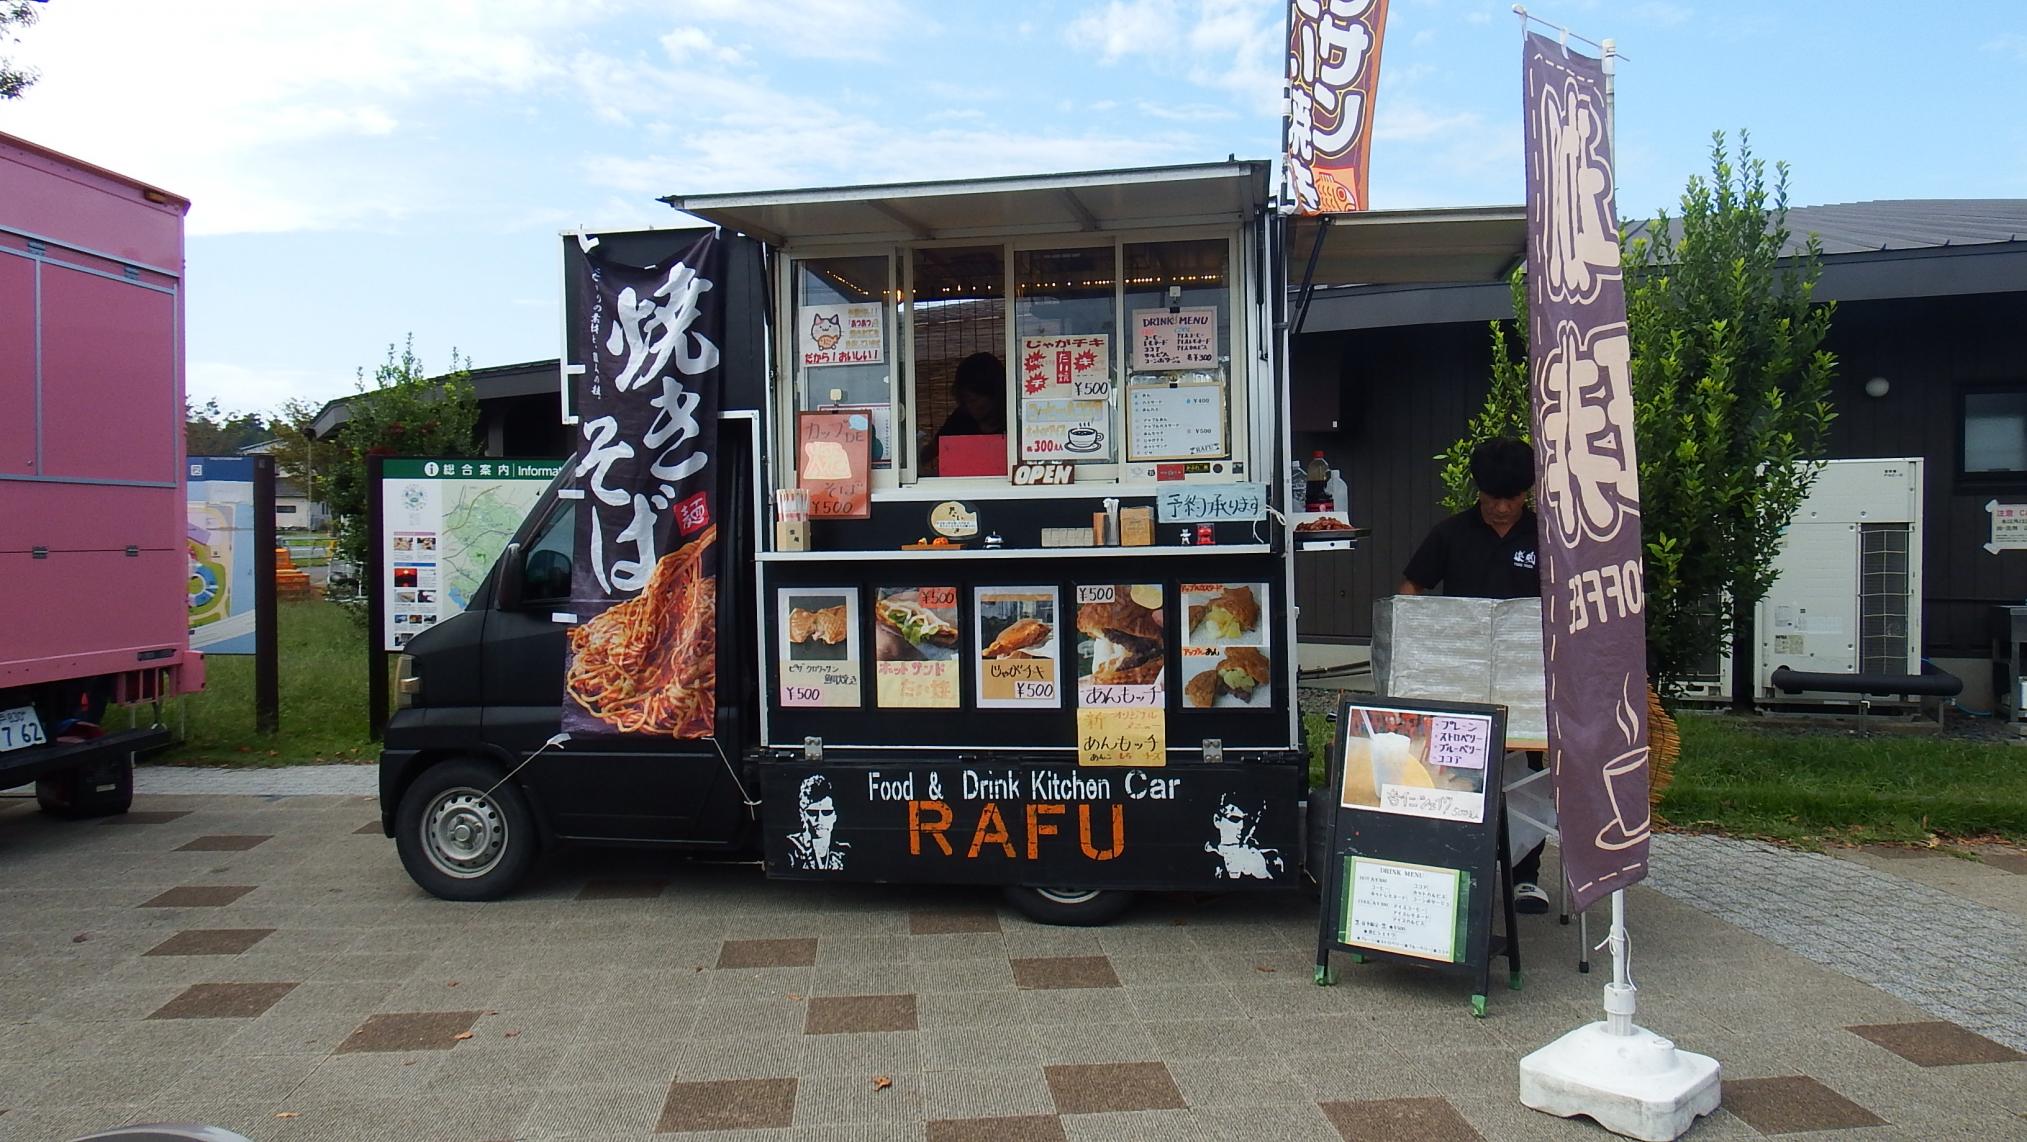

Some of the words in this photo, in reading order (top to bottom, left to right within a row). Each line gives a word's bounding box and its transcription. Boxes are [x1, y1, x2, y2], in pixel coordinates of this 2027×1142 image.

[1143, 317, 1174, 328] DRINK
[1179, 316, 1209, 326] MENU
[1026, 338, 1105, 349] じゃがチキ
[443, 464, 510, 476] 総合案内
[1014, 465, 1073, 485] OPEN
[1167, 493, 1259, 518] 予約承ります
[922, 590, 955, 604] ¥500
[1079, 588, 1114, 601] ¥500
[786, 687, 820, 701] ¥500
[1016, 682, 1053, 699] ¥500
[868, 772, 914, 800] Food
[929, 771, 944, 800] &
[963, 770, 1020, 800] Drink
[1032, 769, 1110, 799] Kitchen
[1125, 769, 1181, 799] Car
[908, 801, 1124, 861] RAFU
[1380, 867, 1402, 877] DRINK
[1404, 870, 1424, 879] MENU
